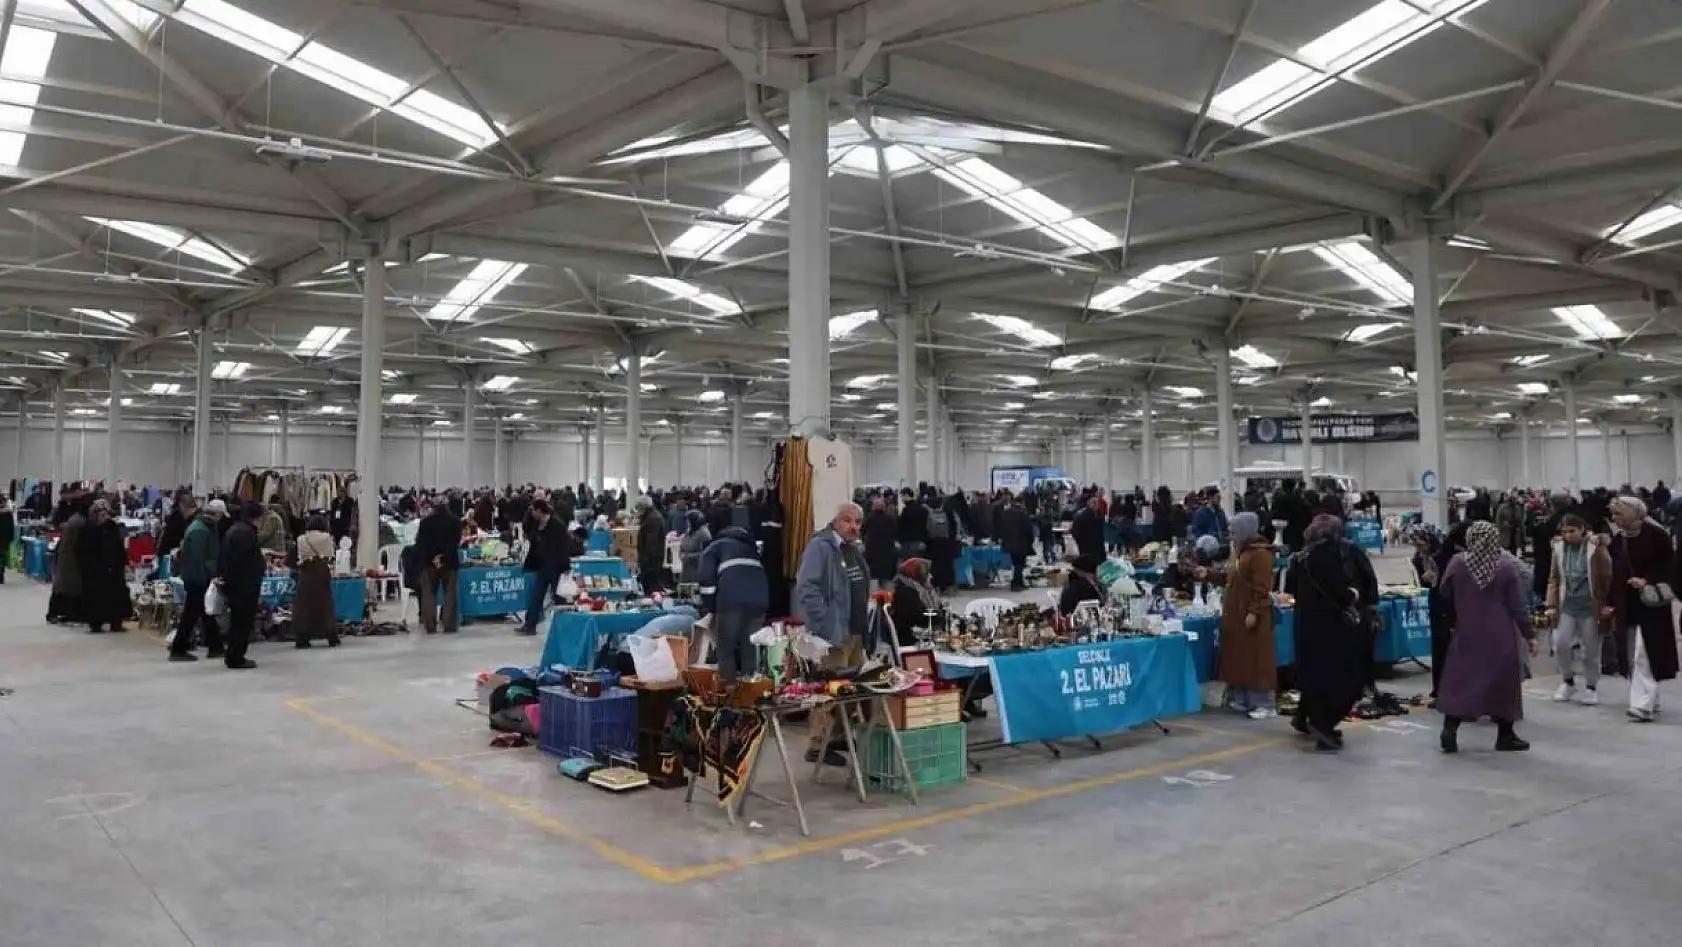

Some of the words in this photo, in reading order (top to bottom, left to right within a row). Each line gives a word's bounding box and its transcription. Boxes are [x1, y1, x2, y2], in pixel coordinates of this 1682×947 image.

[1422, 469, 1436, 494] C
[1060, 670, 1073, 694] 2.
[1074, 668, 1091, 692] EL
